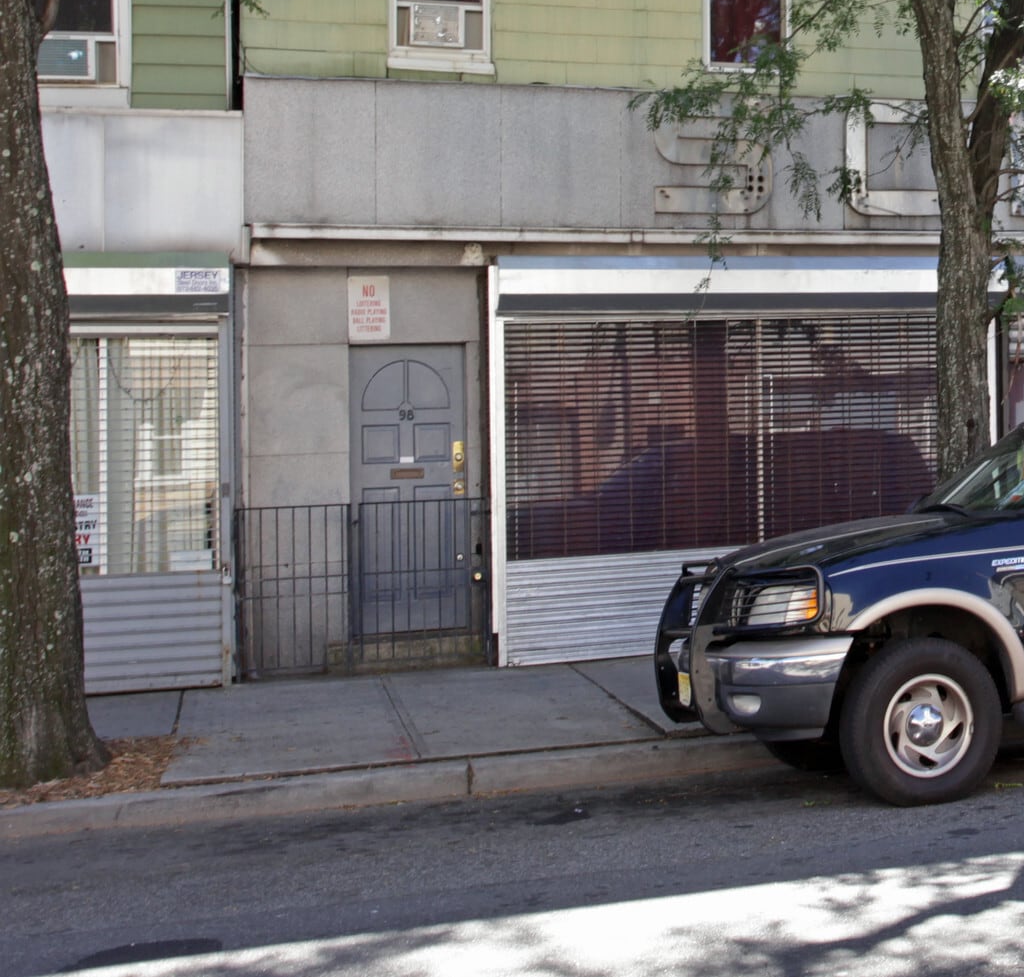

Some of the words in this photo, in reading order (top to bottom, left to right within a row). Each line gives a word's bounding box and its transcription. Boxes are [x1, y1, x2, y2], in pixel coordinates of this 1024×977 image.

[176, 271, 217, 280] JERSEY
[362, 284, 376, 297] NO
[398, 409, 415, 421] 98
